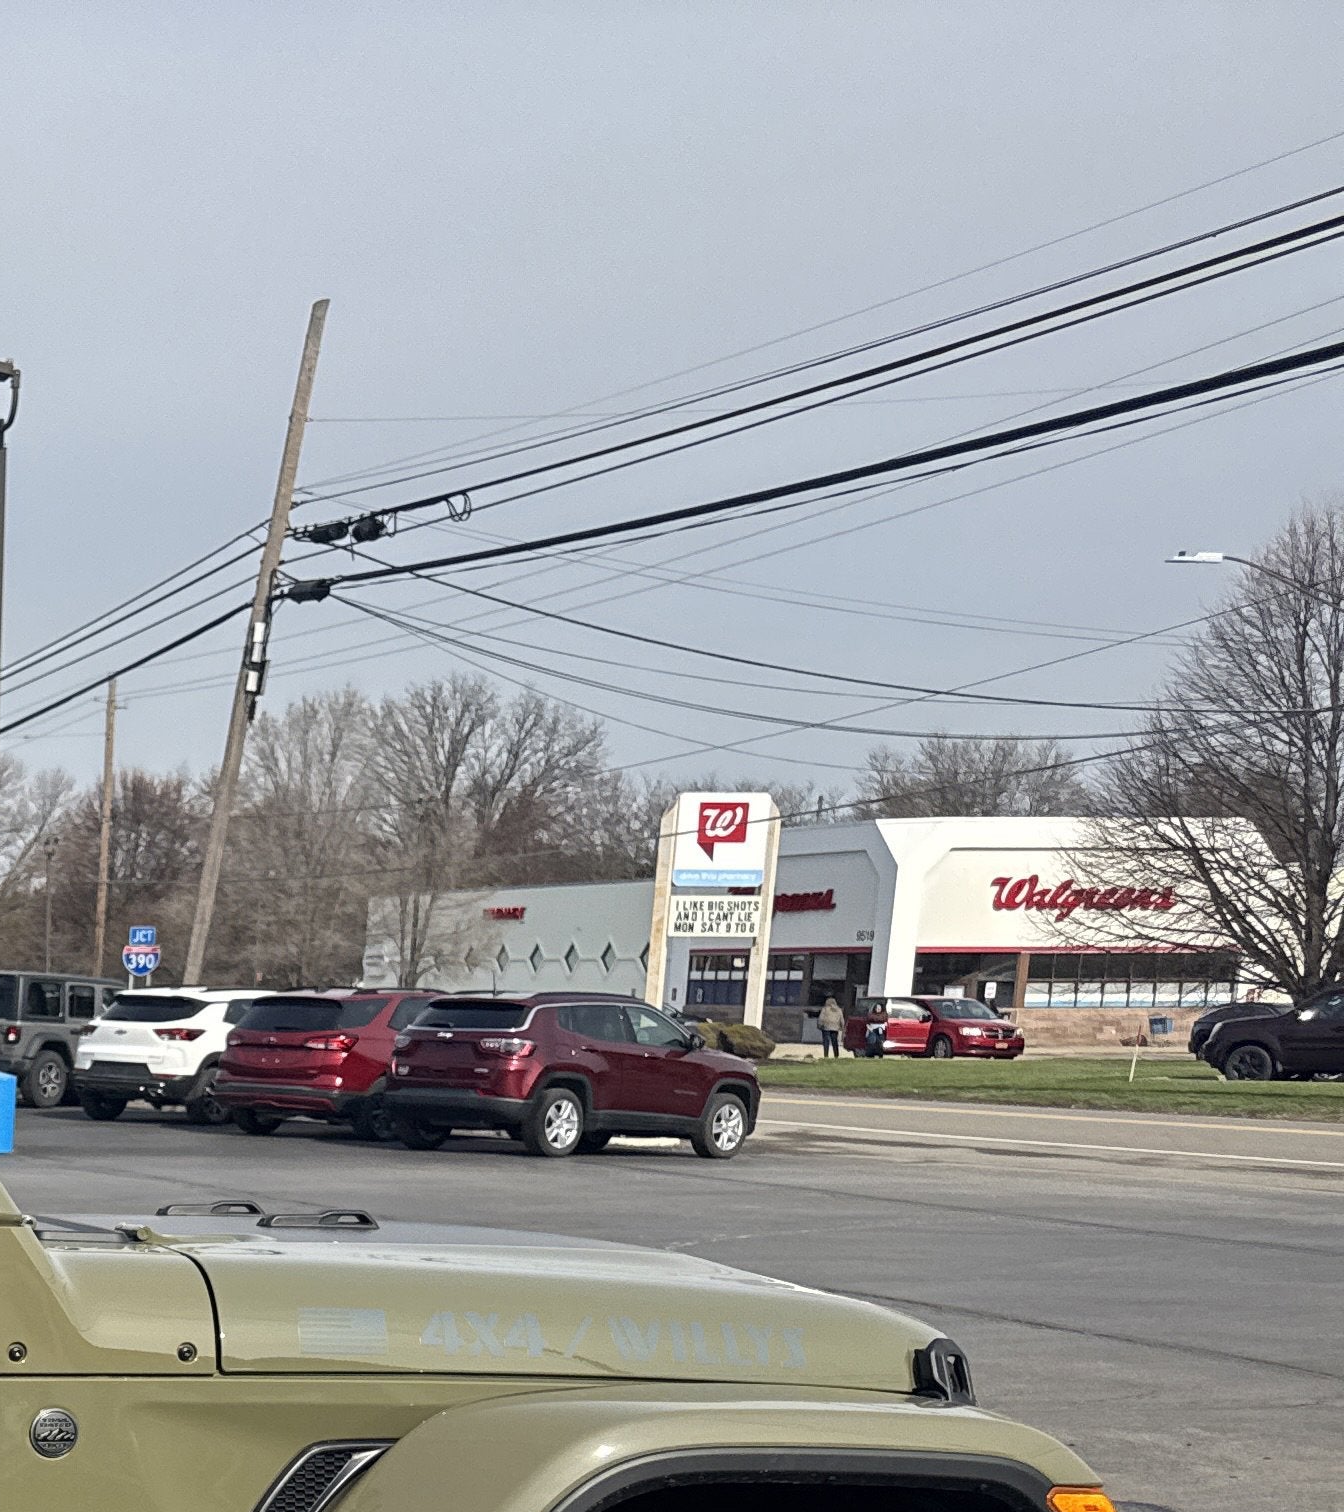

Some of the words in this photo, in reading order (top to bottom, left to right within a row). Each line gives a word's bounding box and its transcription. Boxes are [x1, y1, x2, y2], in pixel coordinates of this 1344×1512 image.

[701, 806, 745, 838] W
[682, 900, 705, 912] LIKE
[707, 900, 725, 912] BIG
[726, 900, 760, 912] SHOTS
[990, 874, 1178, 923] Walgreens
[676, 911, 698, 922] AND
[708, 911, 735, 922] CANT
[737, 911, 753, 922] LIE
[673, 922, 695, 933] MON
[700, 922, 721, 933] SAT
[734, 922, 747, 933] TO
[132, 929, 154, 943] JCT
[127, 953, 156, 969] 390
[419, 1309, 550, 1359] 4X4
[607, 1315, 810, 1370] WILLYS
